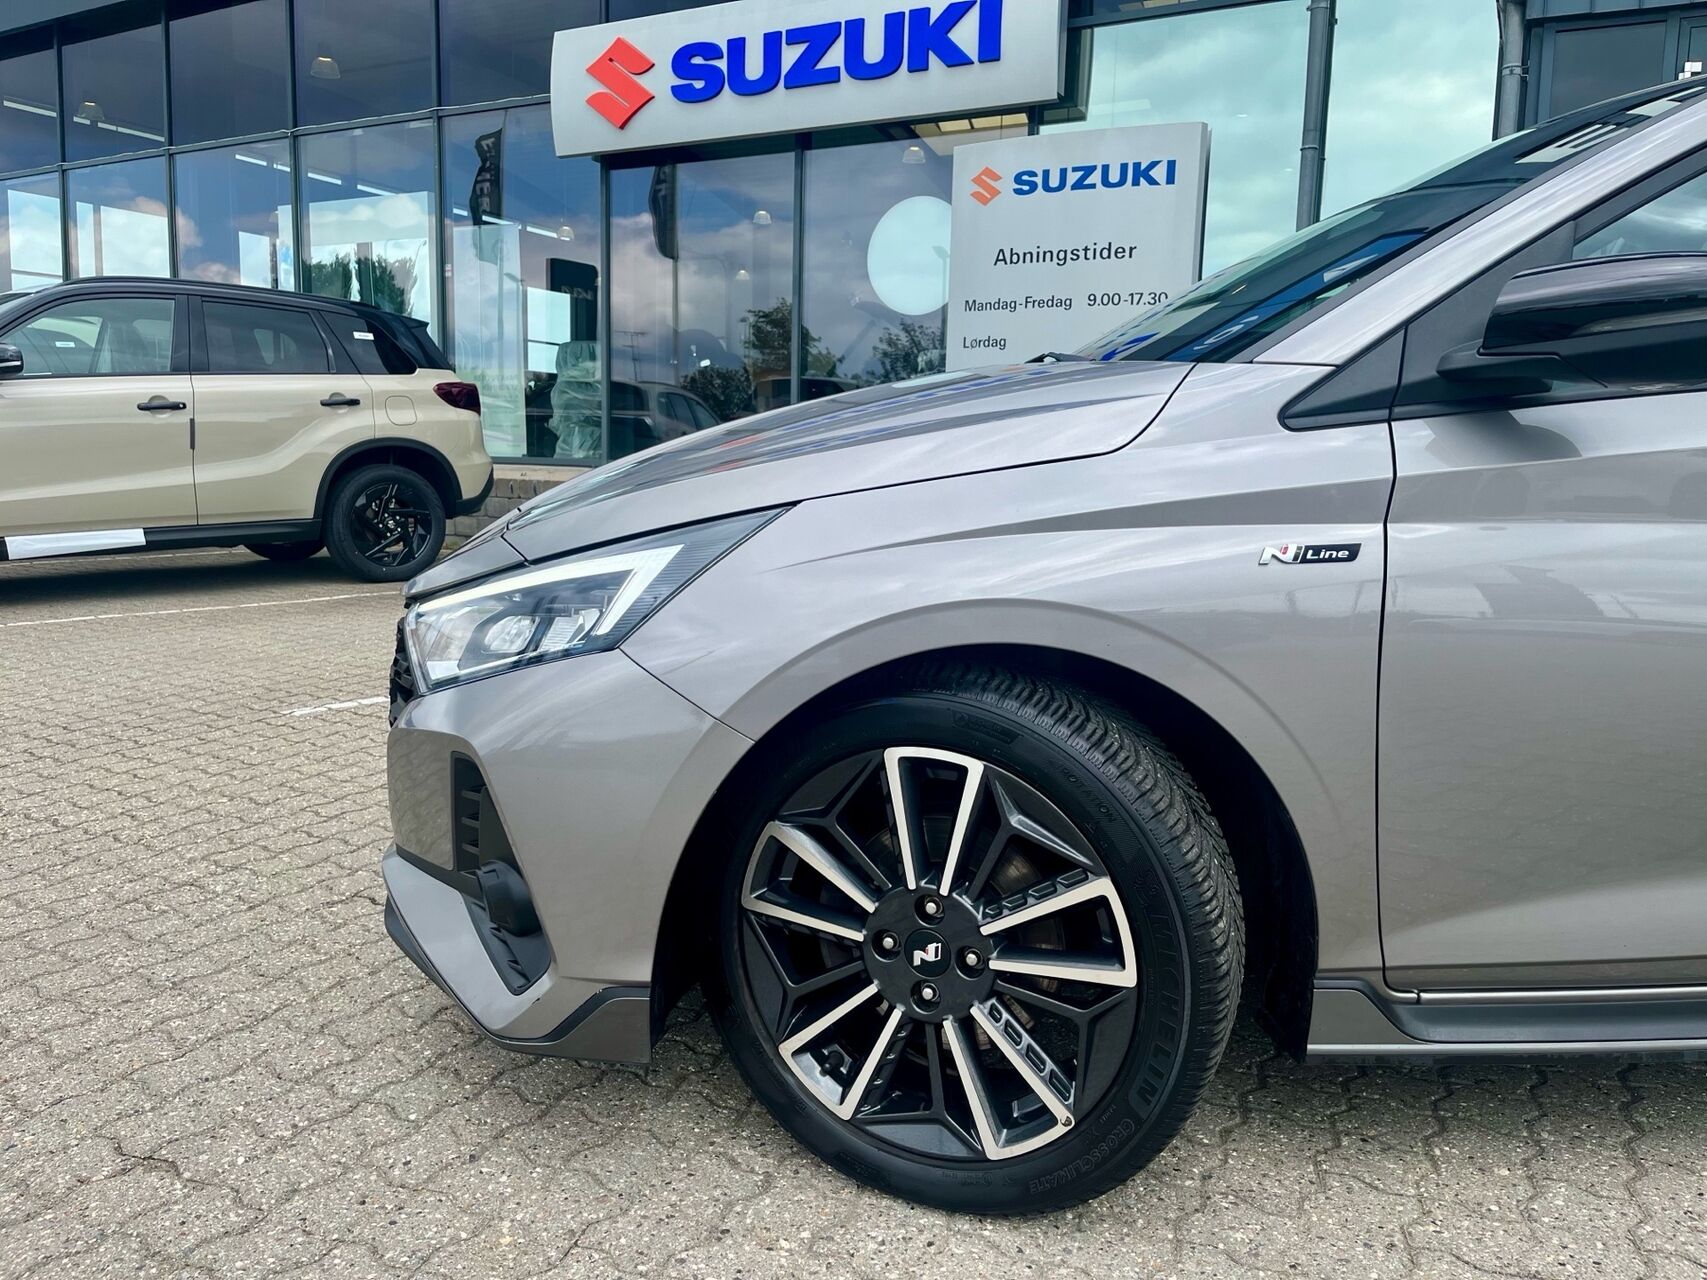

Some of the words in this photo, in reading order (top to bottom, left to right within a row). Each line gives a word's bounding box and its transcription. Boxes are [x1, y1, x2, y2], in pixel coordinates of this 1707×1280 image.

[670, 0, 1003, 103] SUZUKI
[1012, 159, 1177, 196] SUZUKI
[994, 241, 1137, 267] Abningstider
[964, 295, 1073, 313] Mandag-Fredag
[963, 336, 1007, 351] Lørdag
[1306, 549, 1350, 560] Line
[1134, 910, 1183, 1107] MICHELIN
[1027, 1116, 1137, 1197] CROSSCLIMATE
